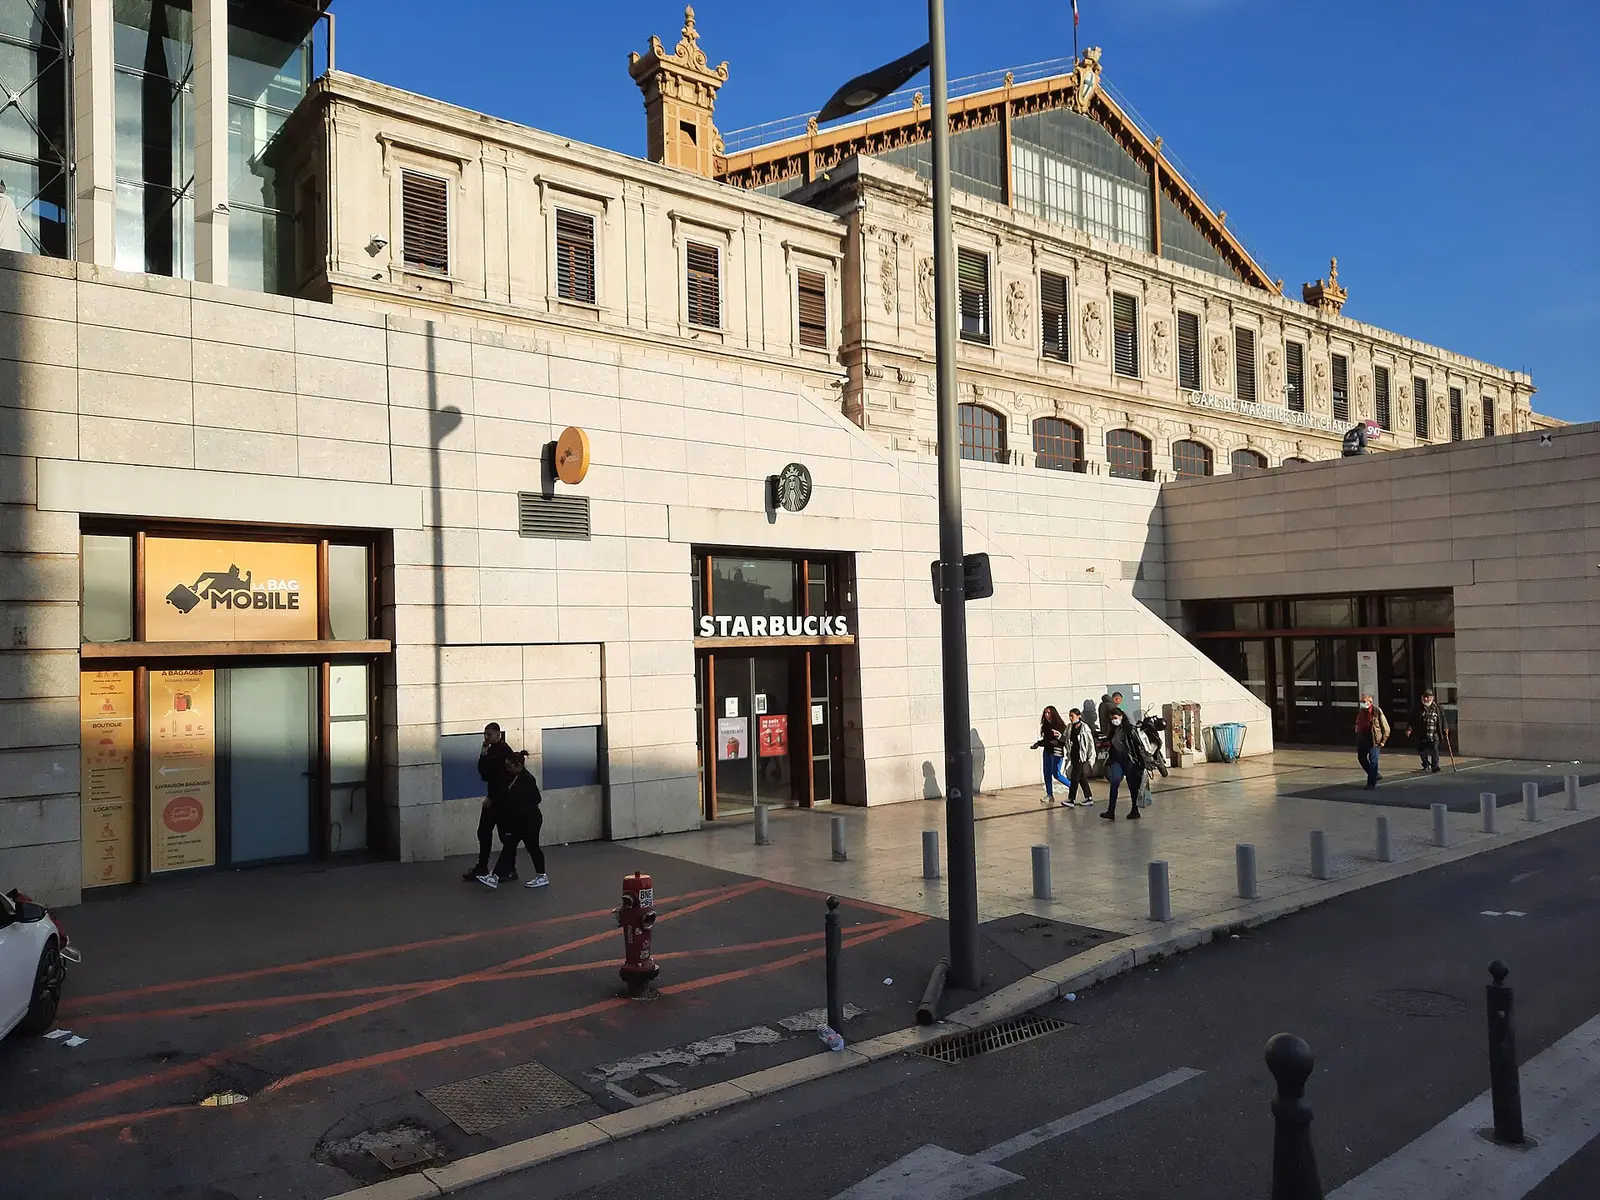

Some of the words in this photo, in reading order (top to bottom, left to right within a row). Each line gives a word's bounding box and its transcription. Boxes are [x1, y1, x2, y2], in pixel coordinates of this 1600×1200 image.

[1191, 391, 1220, 407] GARE
[1224, 397, 1236, 411] DE
[1240, 400, 1289, 421] MARSEILLE
[1291, 410, 1317, 427] SAINT
[252, 583, 265, 592] LA
[267, 579, 300, 592] BAG
[211, 592, 300, 610] MOBILE
[699, 615, 847, 637] STARBUCKS
[154, 782, 184, 790] LIVRAISON
[185, 779, 211, 787] BAGAGES
[93, 805, 123, 813] LOCATION
[640, 889, 652, 900] BNE
